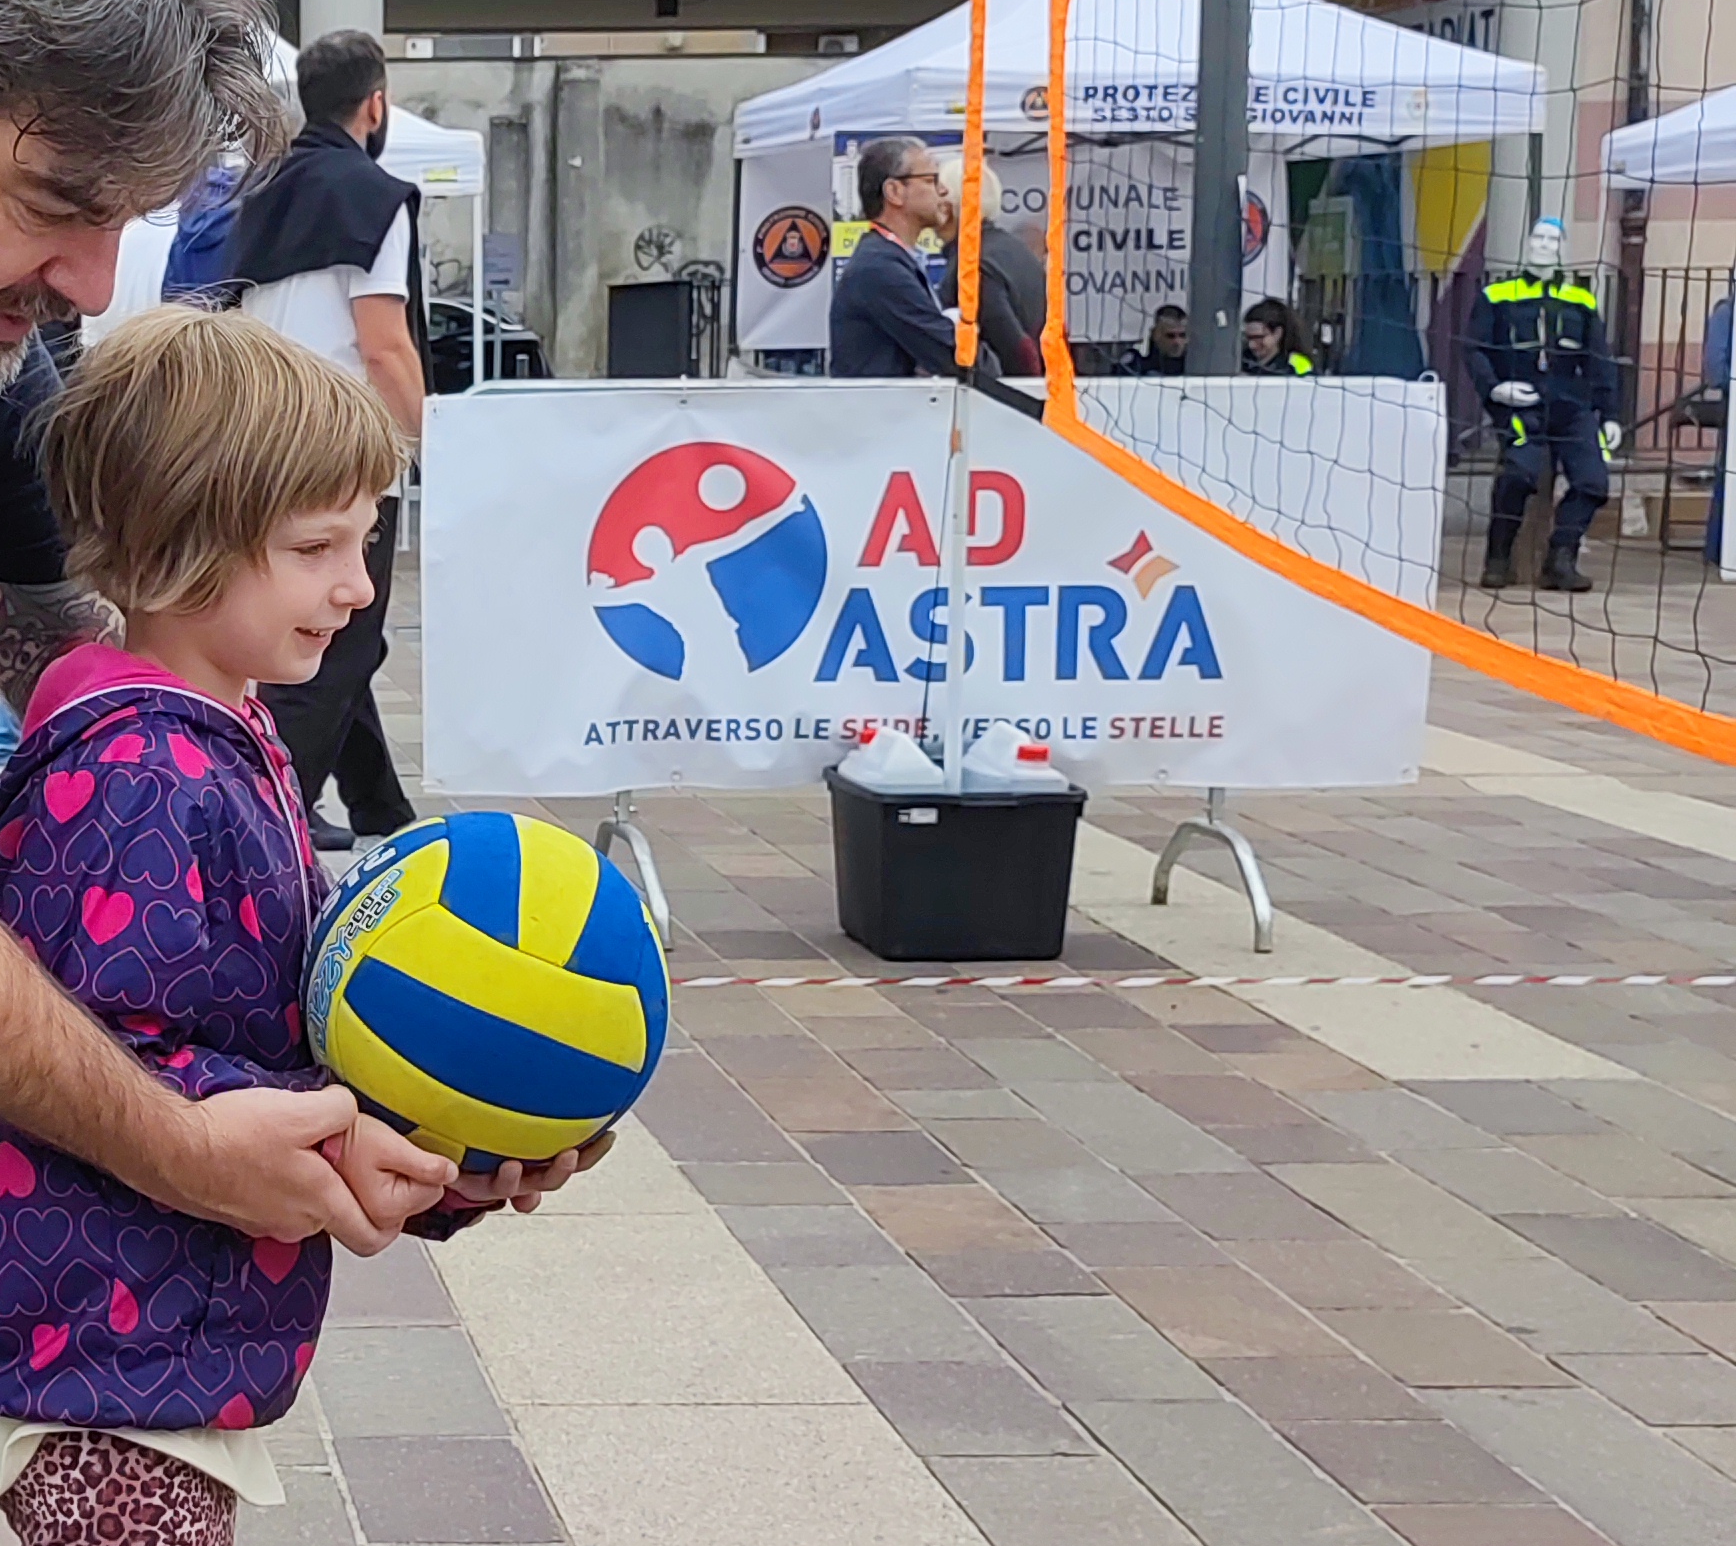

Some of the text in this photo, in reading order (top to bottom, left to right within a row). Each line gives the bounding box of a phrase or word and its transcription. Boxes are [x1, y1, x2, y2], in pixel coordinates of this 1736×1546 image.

[1083, 84, 1377, 108] PROTEZE CIVILE
[1091, 106, 1174, 123] SESTO
[1072, 228, 1187, 252] CIVILE
[1065, 268, 1186, 296] OVANNI
[856, 470, 1026, 568] AD
[813, 585, 1224, 683] ASTRA
[583, 717, 784, 746] ATTRAVERSO
[793, 717, 831, 740] LE
[961, 717, 1052, 741] ESO
[1062, 716, 1098, 740] LE
[1108, 715, 1225, 740] STELLE
[345, 895, 376, 938] 200
[362, 888, 396, 930] 220
